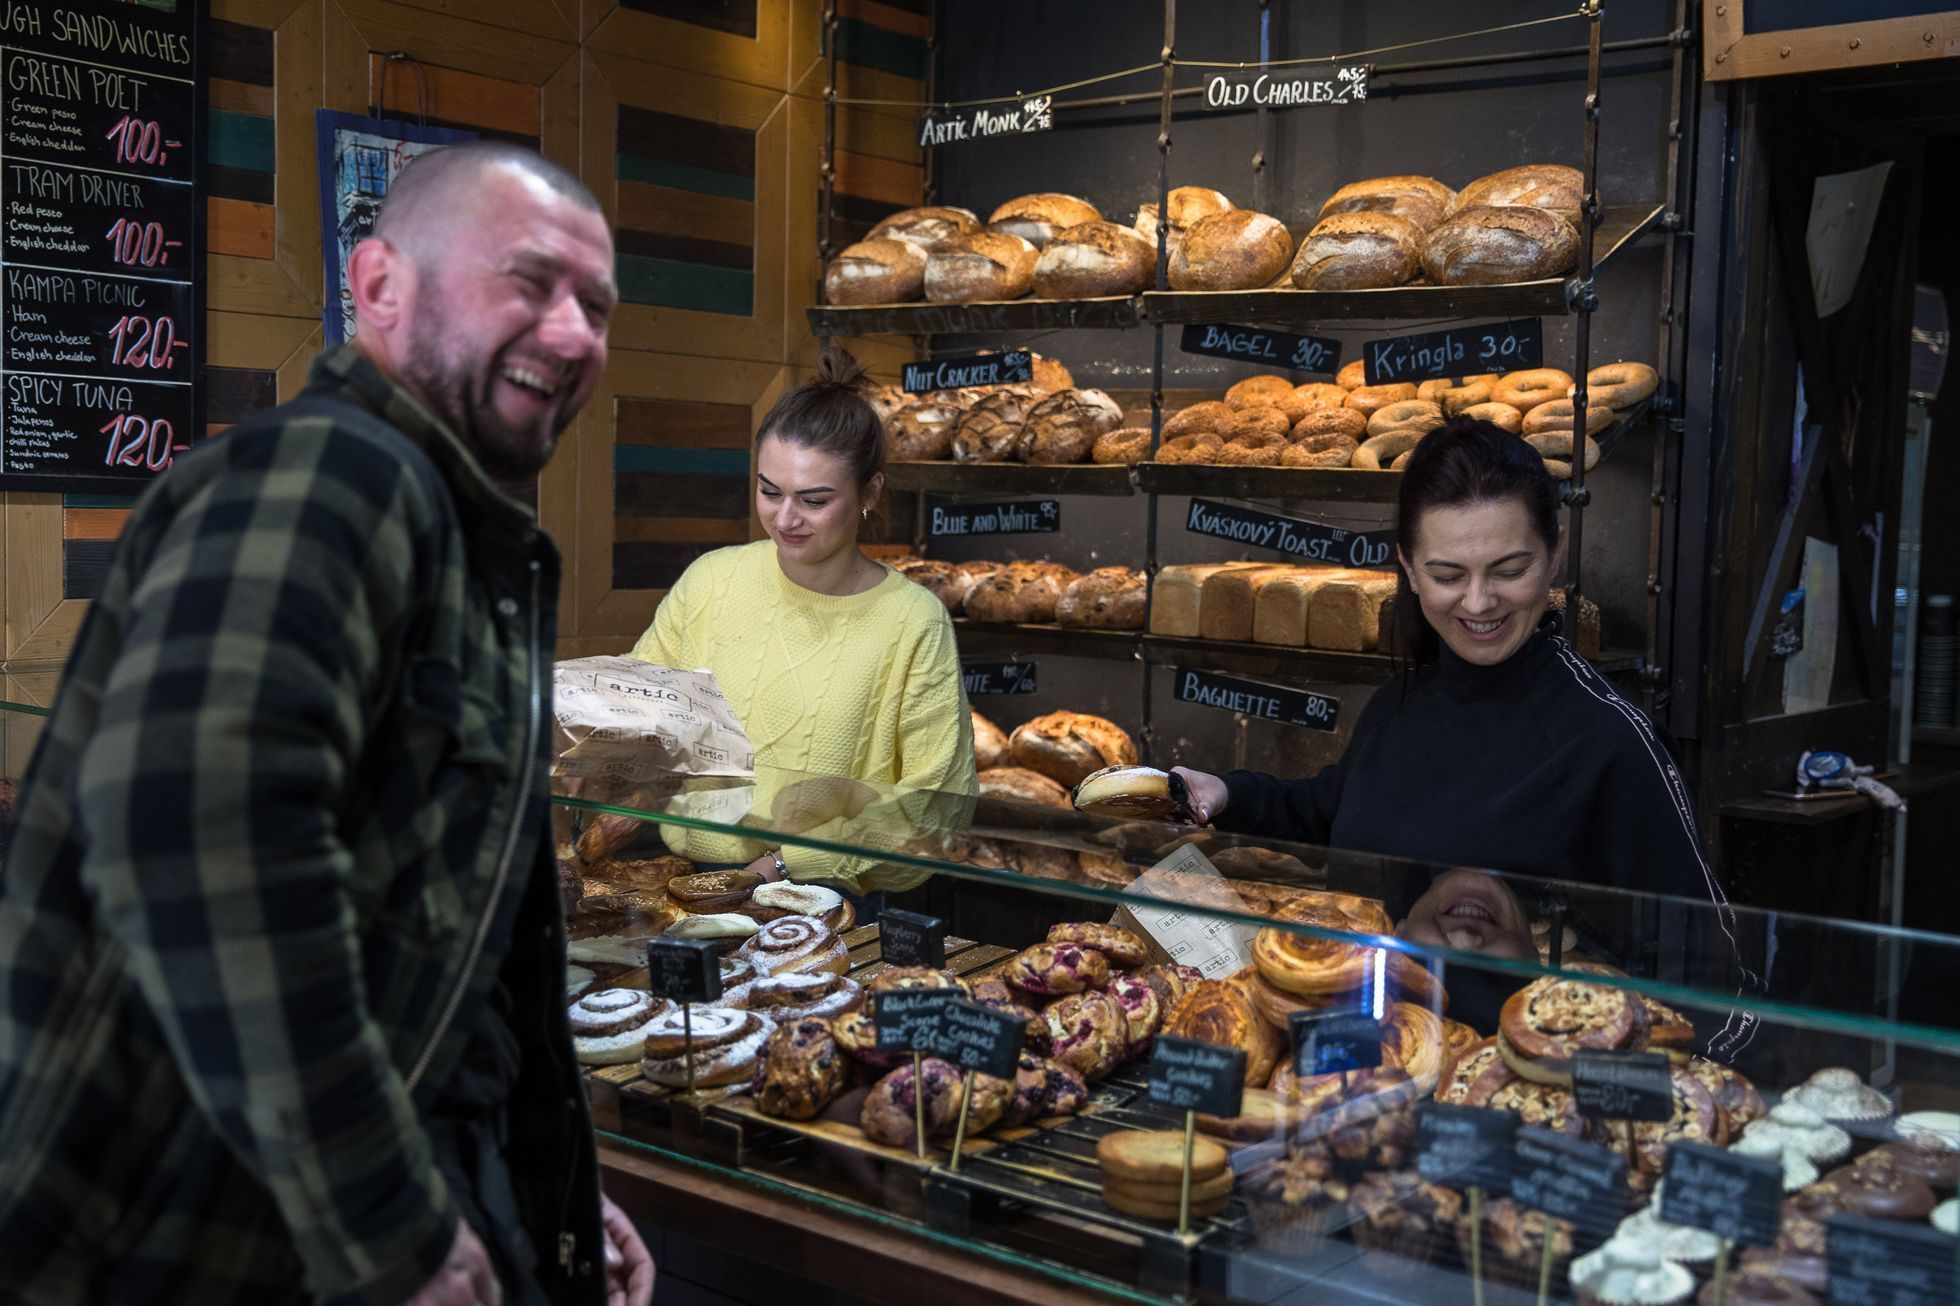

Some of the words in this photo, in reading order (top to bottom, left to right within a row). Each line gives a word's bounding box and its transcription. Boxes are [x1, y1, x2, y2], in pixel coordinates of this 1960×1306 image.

[52, 9, 190, 65] SANDWICHES
[9, 56, 81, 100] GREEN
[88, 69, 148, 112] POET
[1208, 76, 1250, 106] OLD
[1253, 74, 1334, 104] CHARLES
[11, 97, 48, 115] Green
[51, 109, 77, 120] pesto
[11, 115, 47, 130] Cream
[49, 121, 83, 137] cheese
[971, 110, 1021, 138] MONK
[9, 132, 41, 146] English
[42, 138, 86, 151] cheddar
[9, 165, 74, 203] TRAM
[80, 175, 144, 208] DRIVER
[11, 201, 34, 215] Red
[36, 207, 63, 218] pesto
[10, 219, 41, 233] Cream
[43, 222, 74, 235] cheese
[10, 236, 44, 250] English
[46, 237, 90, 253] cheddar
[9, 269, 76, 303] KAMPA
[81, 278, 146, 308] PICNIC
[12, 303, 47, 324] Ham
[10, 325, 52, 343] Cream
[54, 330, 91, 345] cheese
[1200, 324, 1278, 358] BAGEL
[11, 347, 52, 361] English
[55, 350, 96, 362] cheddar
[904, 365, 935, 391] NUT
[936, 362, 998, 388] CRACKER
[8, 375, 63, 405] SPICY
[72, 381, 134, 411] TUNA
[11, 402, 38, 414] Tuna
[11, 461, 34, 470] Pesto
[931, 506, 969, 535] BLUE
[971, 513, 998, 532] AND
[1277, 521, 1332, 560] TOAST
[1350, 535, 1389, 566] OLD
[608, 681, 679, 702] artic
[1182, 671, 1281, 718] BAGUETTE
[667, 711, 697, 722] artic
[645, 733, 673, 747] artic
[698, 747, 724, 762] artic
[1169, 860, 1195, 881] artic
[1204, 954, 1231, 973] artic
